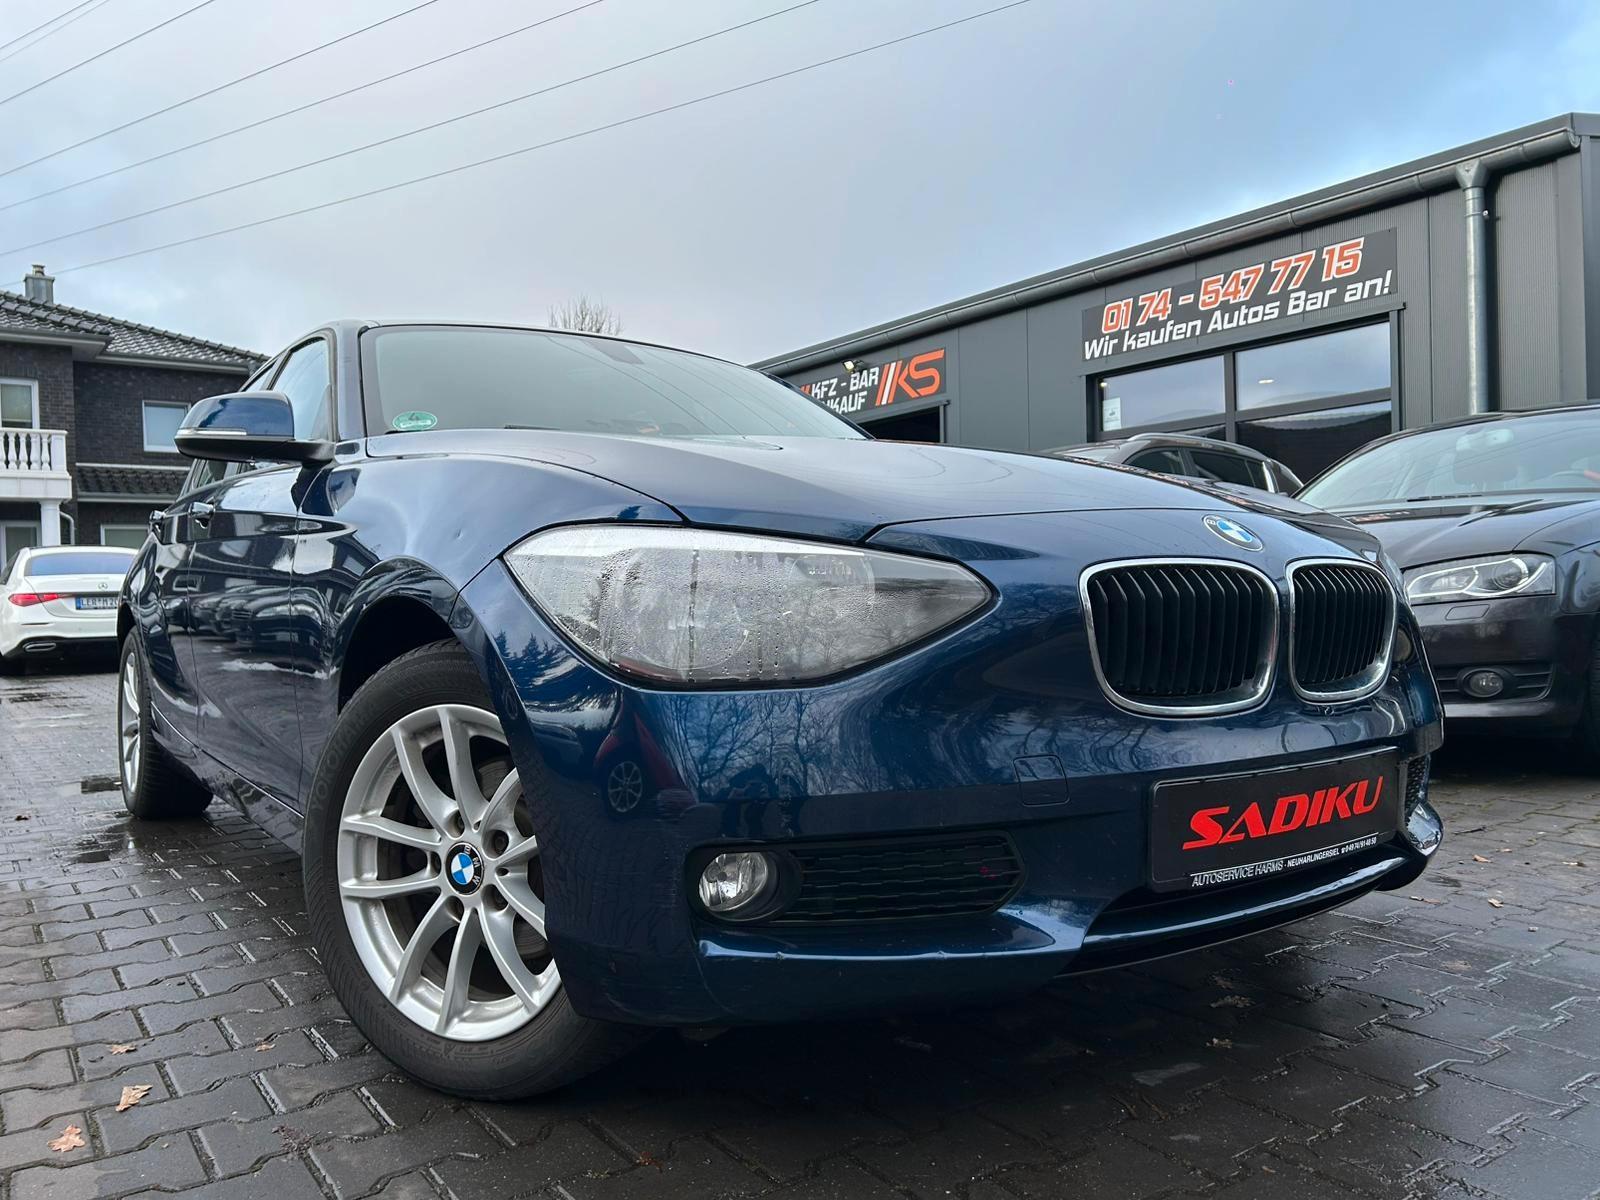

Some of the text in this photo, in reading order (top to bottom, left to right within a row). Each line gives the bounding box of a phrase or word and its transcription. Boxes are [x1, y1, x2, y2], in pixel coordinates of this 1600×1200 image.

[1101, 298, 1133, 334] 01
[1136, 288, 1172, 325] 74
[1198, 264, 1263, 311] 547
[1268, 250, 1316, 295] 77
[1321, 237, 1365, 282] 15
[1084, 270, 1393, 360] Wir kaufen Autos Bar an!
[811, 377, 838, 400] KFZ
[849, 366, 879, 391] BAR
[822, 391, 868, 414] KAUF
[1182, 775, 1384, 850] SADIKU
[1192, 866, 1254, 887] AUTOSERVICE
[1254, 860, 1284, 876] HARMS
[1287, 848, 1340, 868] NEUHARLINGERSIEL
